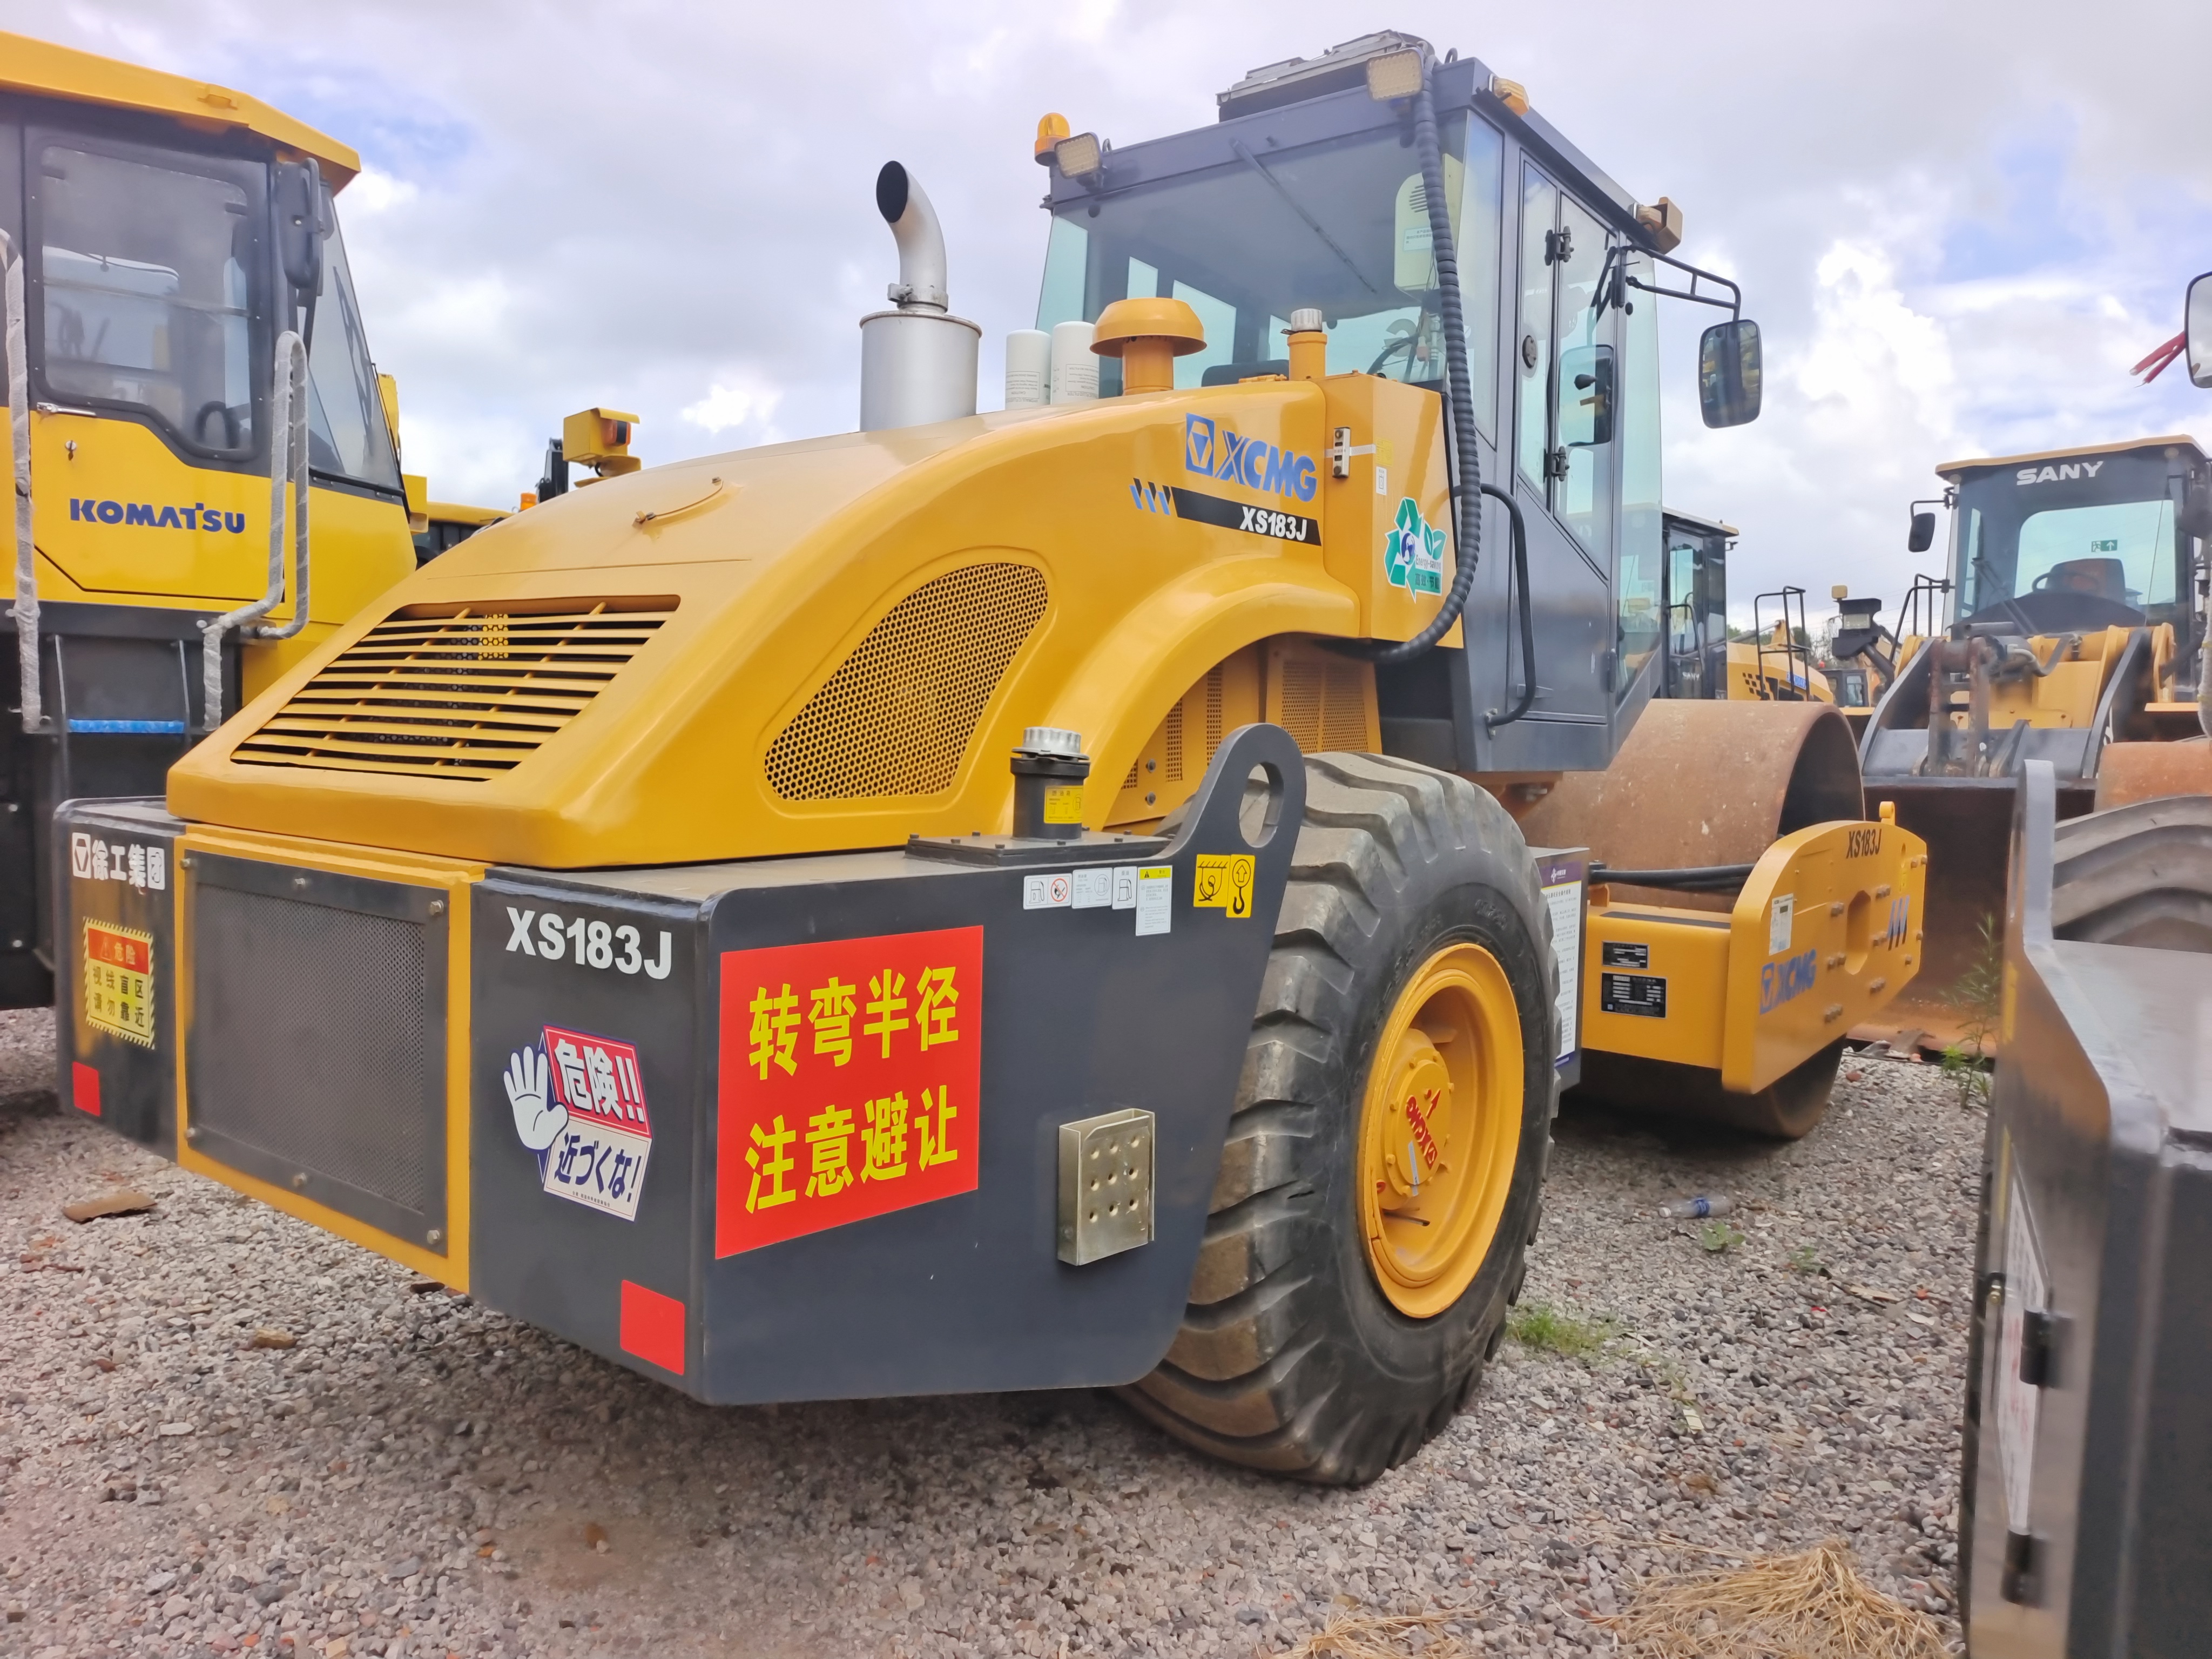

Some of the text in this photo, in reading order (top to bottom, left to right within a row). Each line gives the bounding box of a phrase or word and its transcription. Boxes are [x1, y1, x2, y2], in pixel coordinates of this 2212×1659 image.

[1215, 430, 1317, 502] XCMG
[2017, 461, 2104, 485] SANY
[70, 498, 245, 534] KOMATSU
[1239, 506, 1307, 541] XS183J
[1416, 554, 1441, 572] Energy-saving
[1846, 828, 1882, 859] XS183J
[92, 839, 165, 891] 徐工集团
[114, 941, 136, 965] 危险
[505, 906, 672, 980] XS183J
[93, 965, 144, 999] 视线盲区
[1773, 948, 1817, 1008] XCMG
[93, 992, 145, 1028] 请勿靠近
[748, 966, 960, 1081] 转弯半径
[745, 1084, 958, 1214] 注意避让
